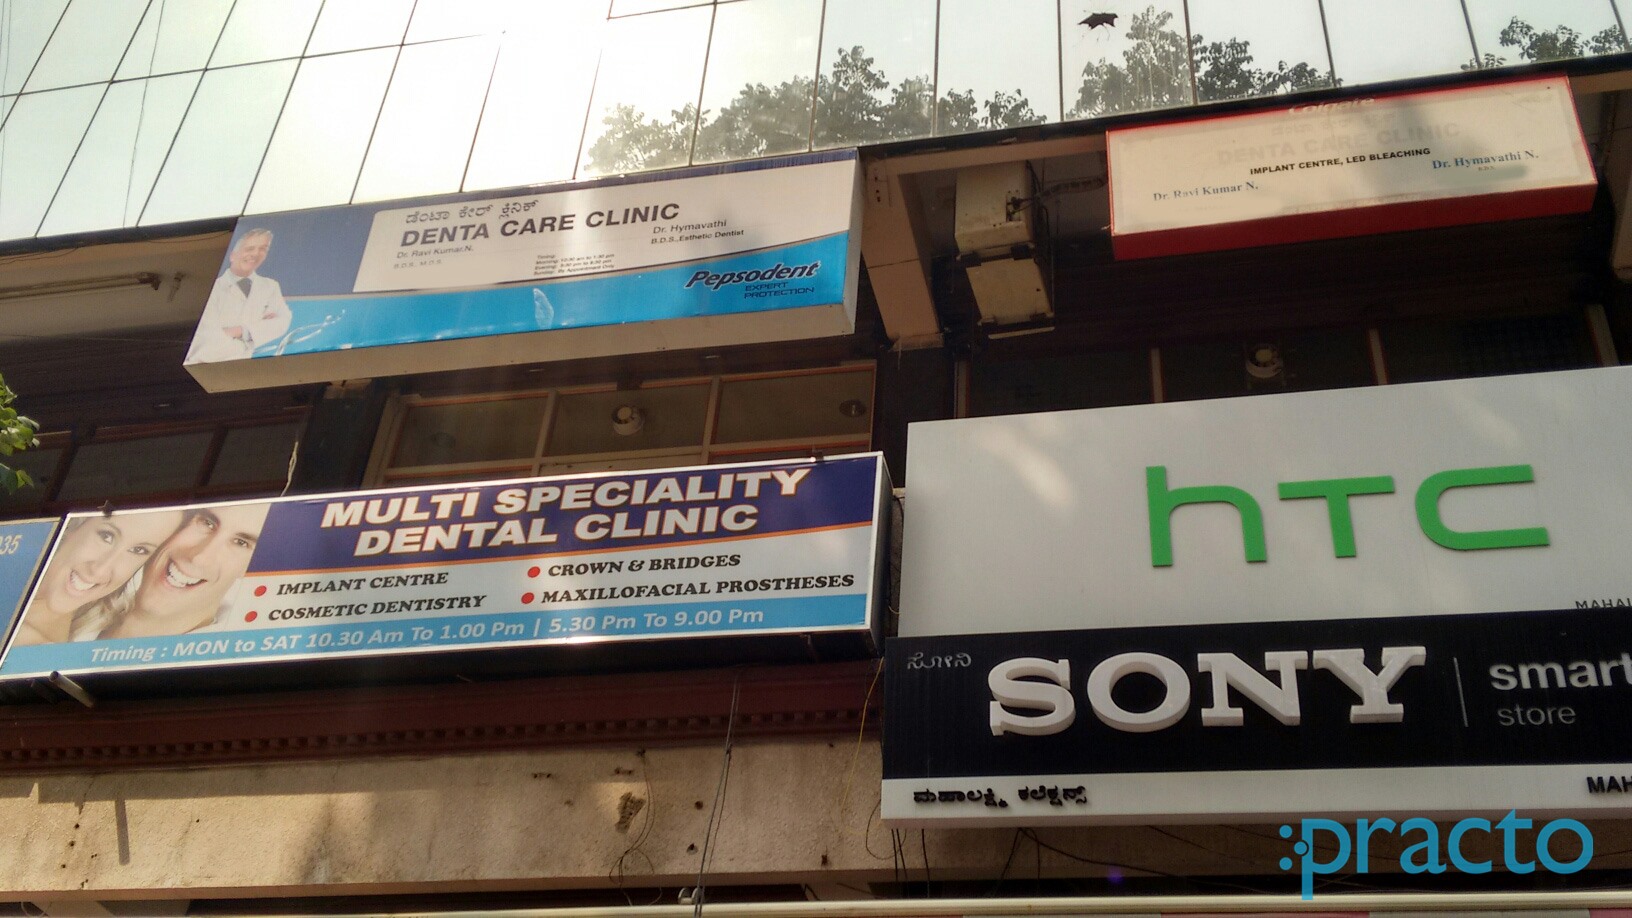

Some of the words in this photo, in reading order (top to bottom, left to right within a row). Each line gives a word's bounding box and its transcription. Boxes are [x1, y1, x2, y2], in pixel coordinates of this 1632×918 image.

[1218, 142, 1295, 164] DENTA
[1304, 134, 1369, 153] CARE
[1376, 122, 1461, 145] CLINIC
[1250, 163, 1295, 175] IMPLANT
[1299, 158, 1344, 169] CENTRE,
[1346, 155, 1367, 164] LED
[1369, 148, 1431, 161] BLEACHING
[1432, 160, 1451, 169] Dr.
[1455, 151, 1521, 168] Hymavathi
[1525, 150, 1539, 159] N.
[1153, 192, 1168, 201] Dr.
[1174, 189, 1198, 198] Ravi
[1202, 184, 1242, 196] Kumar
[1246, 181, 1259, 190] N.
[400, 223, 490, 247] DENTA
[500, 214, 576, 237] CARE
[586, 203, 680, 228] CLINIC
[653, 226, 667, 234] Dr.
[670, 219, 728, 233] Hymavathi
[715, 230, 745, 239] Dentist
[396, 251, 408, 259] Dr.
[411, 249, 432, 257] Ravi
[684, 260, 821, 292] Pepsodent
[745, 282, 789, 291] EXPERT
[744, 287, 815, 299] PROTECTION
[320, 491, 481, 528] MULTI
[493, 469, 811, 515] SPECIALITY
[353, 518, 558, 557] DENTAL
[575, 504, 760, 541] CLINIC
[548, 561, 624, 577] CROWN
[628, 560, 645, 572] &
[648, 554, 741, 571] BRIDGES
[276, 578, 366, 596] IMPLANT
[369, 572, 449, 589] CENTRE
[541, 582, 711, 604] MAXILLOFACIAL
[715, 574, 854, 594] PROSTHESES
[268, 604, 367, 621] COSMETIC
[370, 594, 487, 615] DENTISTRY
[91, 645, 156, 663] Timing
[173, 639, 229, 657] MON
[234, 640, 256, 653] to
[260, 634, 302, 651] SAT
[305, 630, 364, 648] 10.30
[367, 629, 404, 645] Am
[411, 626, 434, 641] To
[440, 623, 486, 639] 1.00
[491, 622, 524, 637] Pm
[549, 617, 596, 633] 5.30
[602, 614, 636, 630] Pm
[644, 612, 668, 627] To
[674, 609, 723, 626] 9.00
[728, 608, 764, 624] Pm
[907, 652, 972, 670] ಸೋನಿ
[1489, 652, 1632, 690] smart
[988, 645, 1427, 736] SONY
[1497, 704, 1576, 726] store
